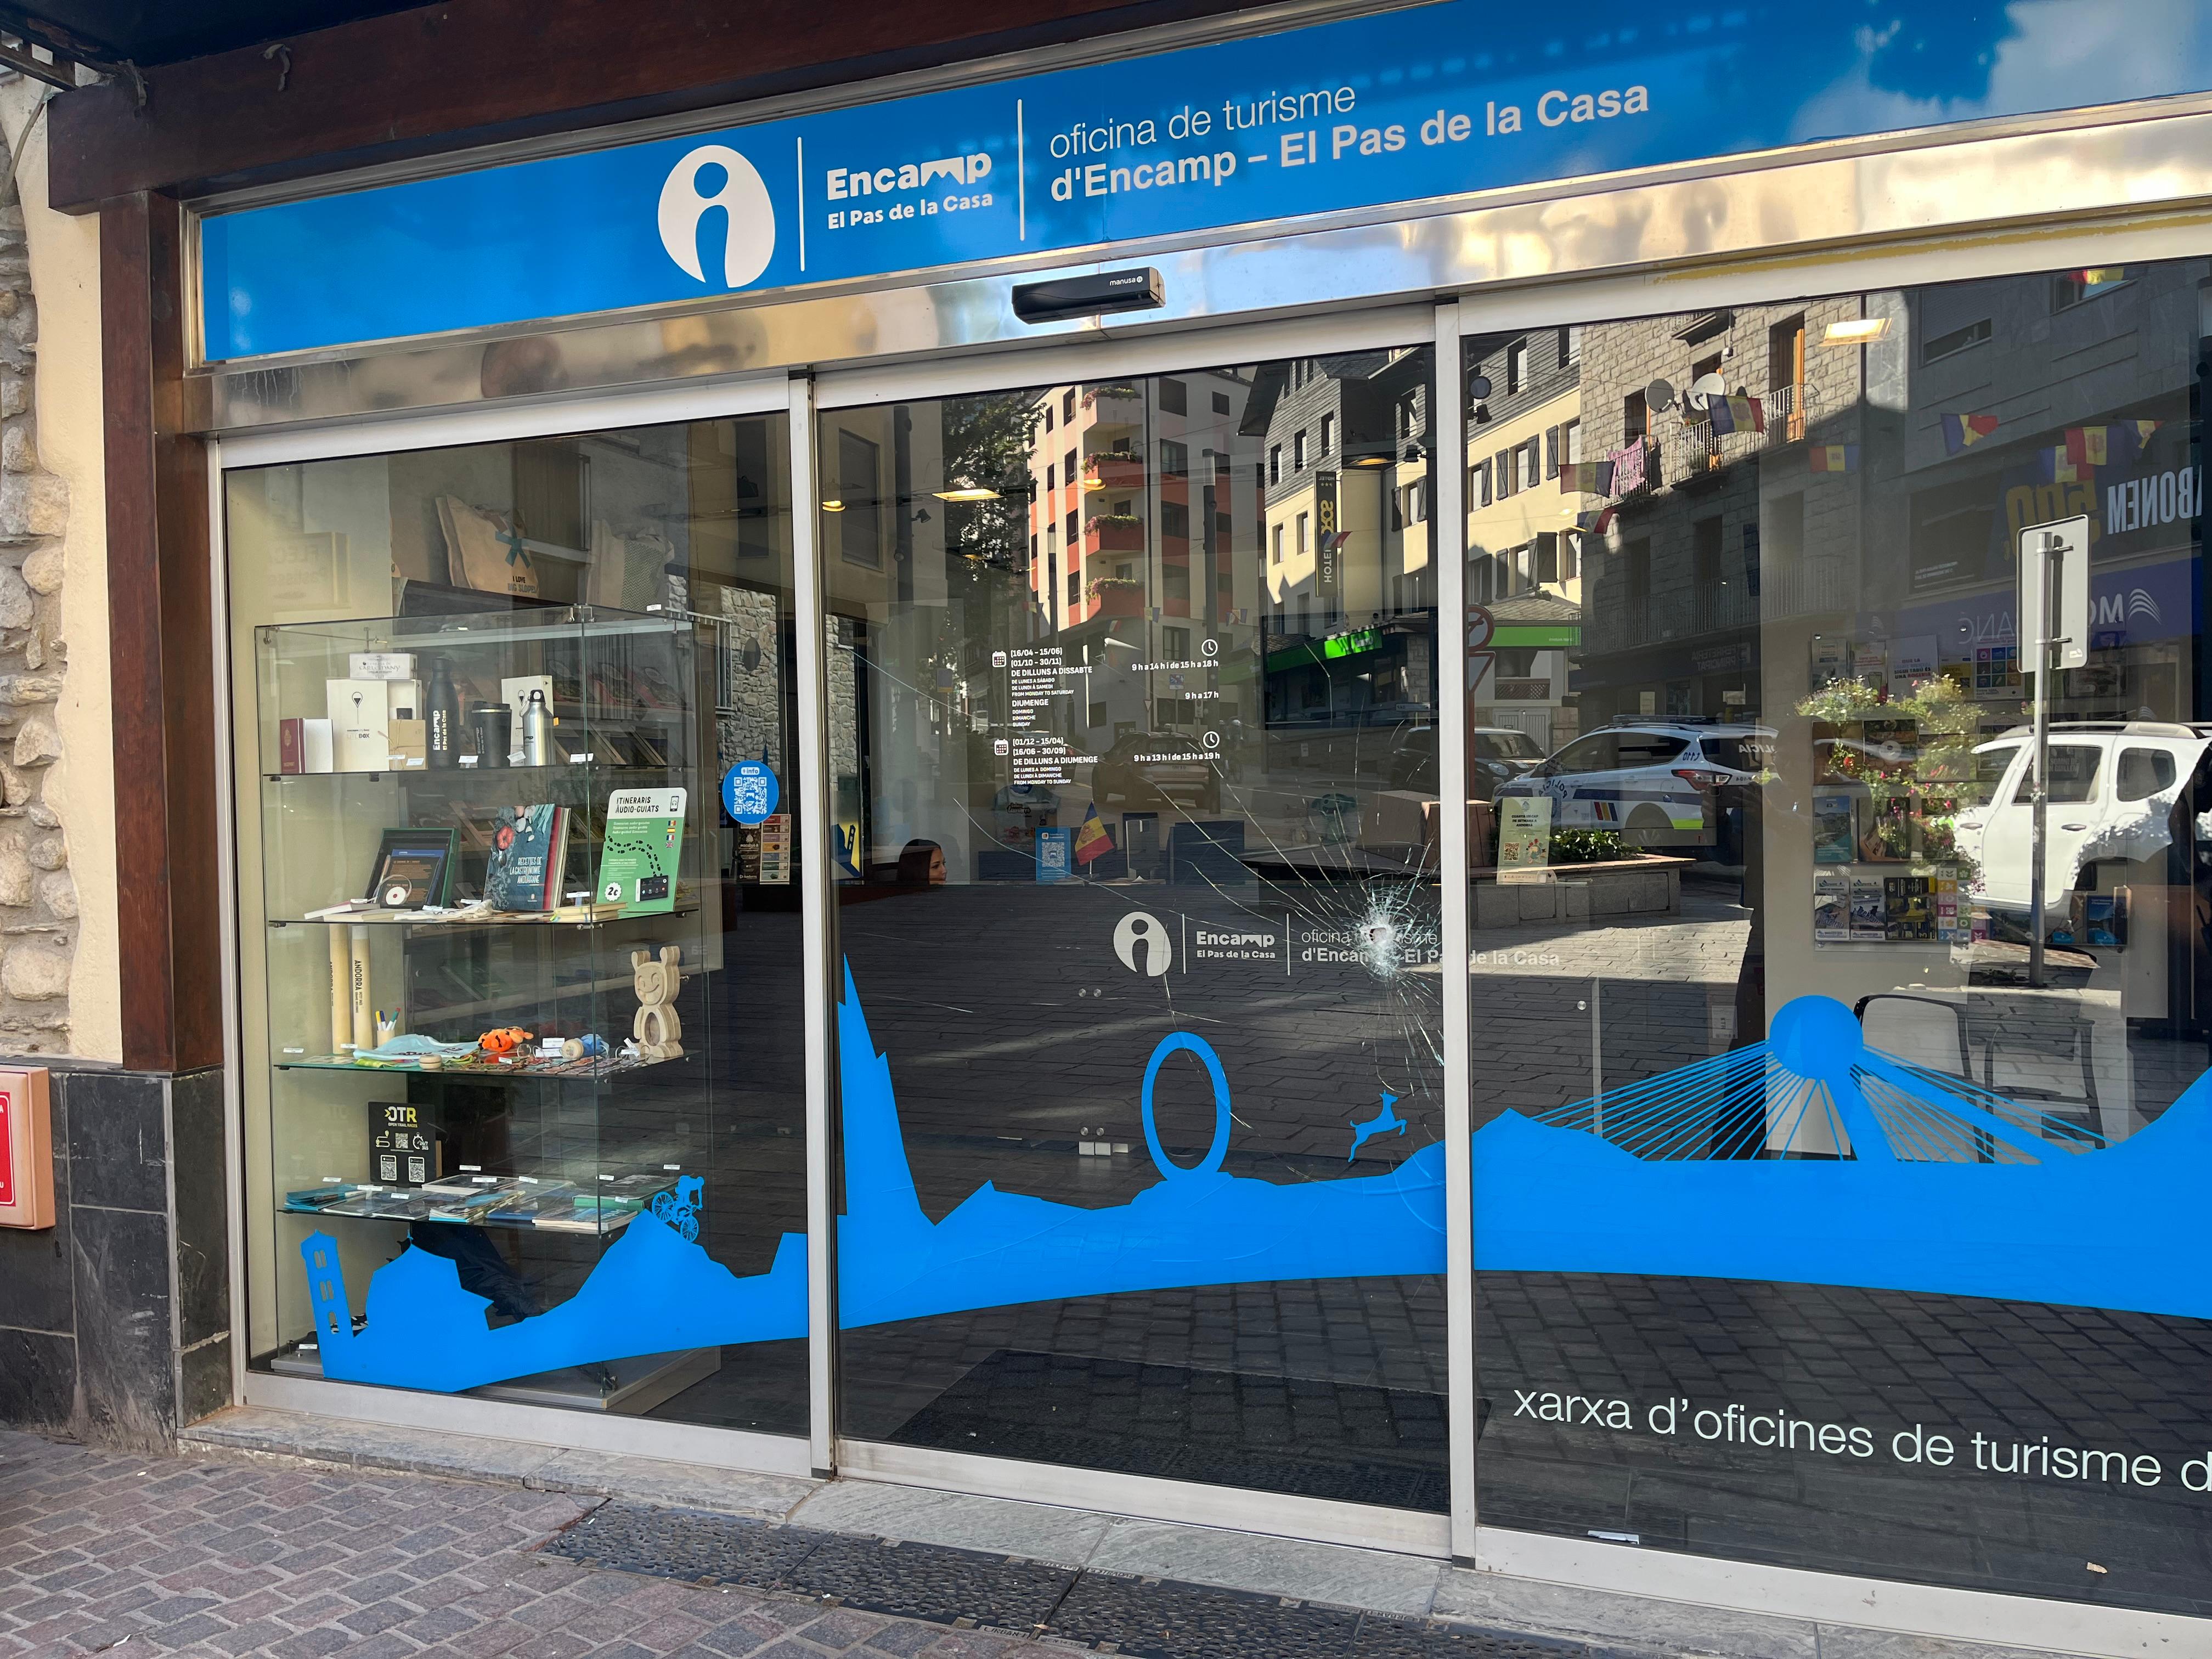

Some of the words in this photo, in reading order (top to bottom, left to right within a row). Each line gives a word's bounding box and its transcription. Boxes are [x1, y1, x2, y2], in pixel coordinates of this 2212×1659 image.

[1049, 114, 1156, 159] oficina
[1168, 107, 1211, 141] de
[1222, 86, 1356, 128] turisme
[1049, 146, 1236, 202] d'Encamp
[1279, 130, 1316, 167] El
[1332, 124, 1407, 161] Pas
[1420, 110, 1471, 146] de
[1486, 101, 1522, 136] la
[1536, 84, 1649, 127] Casa
[827, 153, 992, 201] Encamp
[828, 211, 845, 229] El
[850, 210, 884, 227] Pas
[889, 204, 915, 220] de
[920, 199, 938, 216] la
[943, 193, 992, 212] Casa
[1109, 277, 1136, 286] manusa
[1011, 649, 1033, 658] (16/04
[1040, 647, 1063, 656] 15/06)
[1011, 659, 1033, 668] (01/10
[1040, 657, 1062, 666] 30/11)
[1022, 668, 1051, 676] DILLUNS
[1058, 666, 1092, 674] DISSABTE
[1012, 698, 1049, 707] DIUMENGE
[1013, 738, 1035, 747] (01/12
[1041, 737, 1064, 745] 15/04)
[1013, 748, 1036, 757] (16/06
[1042, 747, 1065, 755] 30/09)
[617, 796, 651, 805] ITINERARIS
[1196, 931, 1275, 947] Encamp
[1301, 929, 1350, 943] oficina
[1241, 950, 1250, 958] la
[1251, 950, 1276, 958] Casa
[1493, 950, 1508, 965] la
[1514, 950, 1560, 966] Casa
[354, 960, 363, 991] ANDORRA
[1514, 1389, 1632, 1431] xarxa
[1648, 1397, 1875, 1458] d’oficines
[1892, 1424, 1955, 1466] de
[1971, 1431, 2163, 1488] turisme
